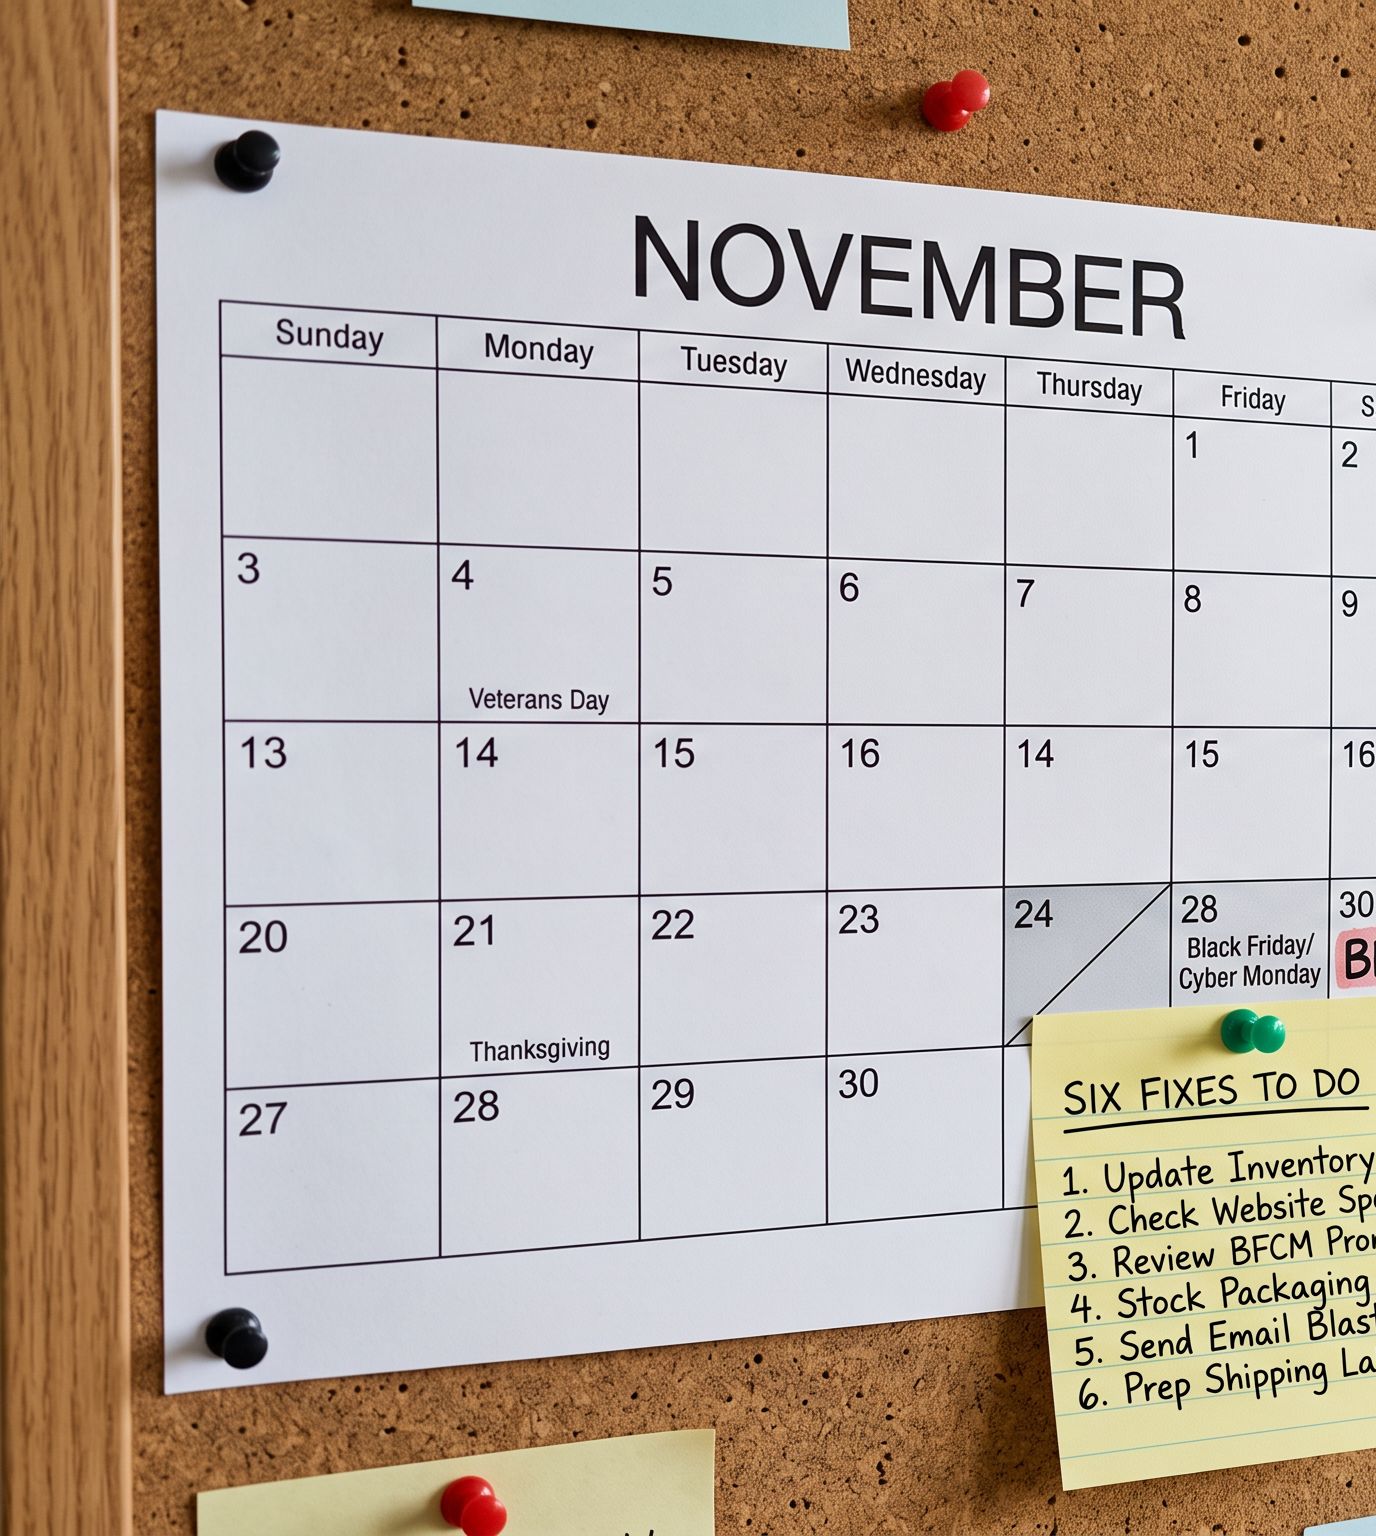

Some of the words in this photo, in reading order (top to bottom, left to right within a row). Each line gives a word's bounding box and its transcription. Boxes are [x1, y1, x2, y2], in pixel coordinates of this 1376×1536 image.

[634, 214, 1187, 340] NOVEMBER
[275, 318, 385, 356] Sunday
[484, 333, 595, 370] Monday
[680, 346, 788, 381] Tuesday
[845, 357, 987, 395] Wednesday
[1037, 371, 1143, 405] Thursday
[1221, 385, 1286, 416] Friday
[1184, 431, 1199, 459] 1
[1341, 440, 1359, 469] 2
[236, 552, 261, 585] 3
[451, 560, 475, 591] 4
[651, 567, 674, 597] 5
[838, 572, 860, 602] 6
[1016, 579, 1035, 607] 7
[1183, 585, 1202, 613] 8
[1341, 590, 1359, 618] 9
[468, 687, 563, 712] Veterans
[569, 689, 610, 715] Day
[239, 736, 288, 770] 13
[455, 737, 499, 768] 14
[652, 737, 696, 768] 15
[840, 738, 880, 768] 16
[1017, 739, 1055, 768] 14
[1185, 740, 1220, 768] 15
[1342, 741, 1376, 768] 16
[838, 905, 880, 934] 23
[1014, 900, 1054, 929] 24
[1181, 895, 1218, 923] 28
[1339, 891, 1375, 918] 30
[237, 920, 288, 954] 20
[452, 914, 497, 947] 21
[651, 910, 696, 940] 22
[1187, 936, 1242, 959] Black
[1247, 933, 1316, 960] Friday/
[1179, 966, 1238, 993] Cyber
[1243, 963, 1322, 992] Monday
[469, 1035, 611, 1066] Thanksgiving
[651, 1079, 696, 1111] 29
[836, 1066, 881, 1101] 30
[1064, 1080, 1123, 1116] SIX
[1140, 1074, 1238, 1110] FIXES
[1253, 1071, 1297, 1102] TO
[1314, 1067, 1361, 1098] DO
[237, 1102, 289, 1137] 27
[452, 1091, 500, 1123] 28
[1062, 1166, 1088, 1196] 1.
[1104, 1158, 1215, 1201] Update
[1227, 1145, 1376, 1183] Inventory
[1064, 1210, 1093, 1239] 2.
[1108, 1200, 1199, 1235] Check
[1212, 1189, 1326, 1226] Website
[1067, 1252, 1097, 1281] 3.
[1113, 1243, 1215, 1277] Review
[1231, 1230, 1314, 1265] BFCM
[1071, 1294, 1102, 1324] 4.
[1117, 1283, 1206, 1320] Stock
[1220, 1271, 1371, 1313] Packaging
[1074, 1337, 1103, 1366] 5.
[1120, 1325, 1193, 1361] Send
[1210, 1312, 1291, 1349] Email
[1078, 1377, 1107, 1410] 6.
[1124, 1372, 1191, 1410] Prep
[1205, 1358, 1329, 1399] Shipping
